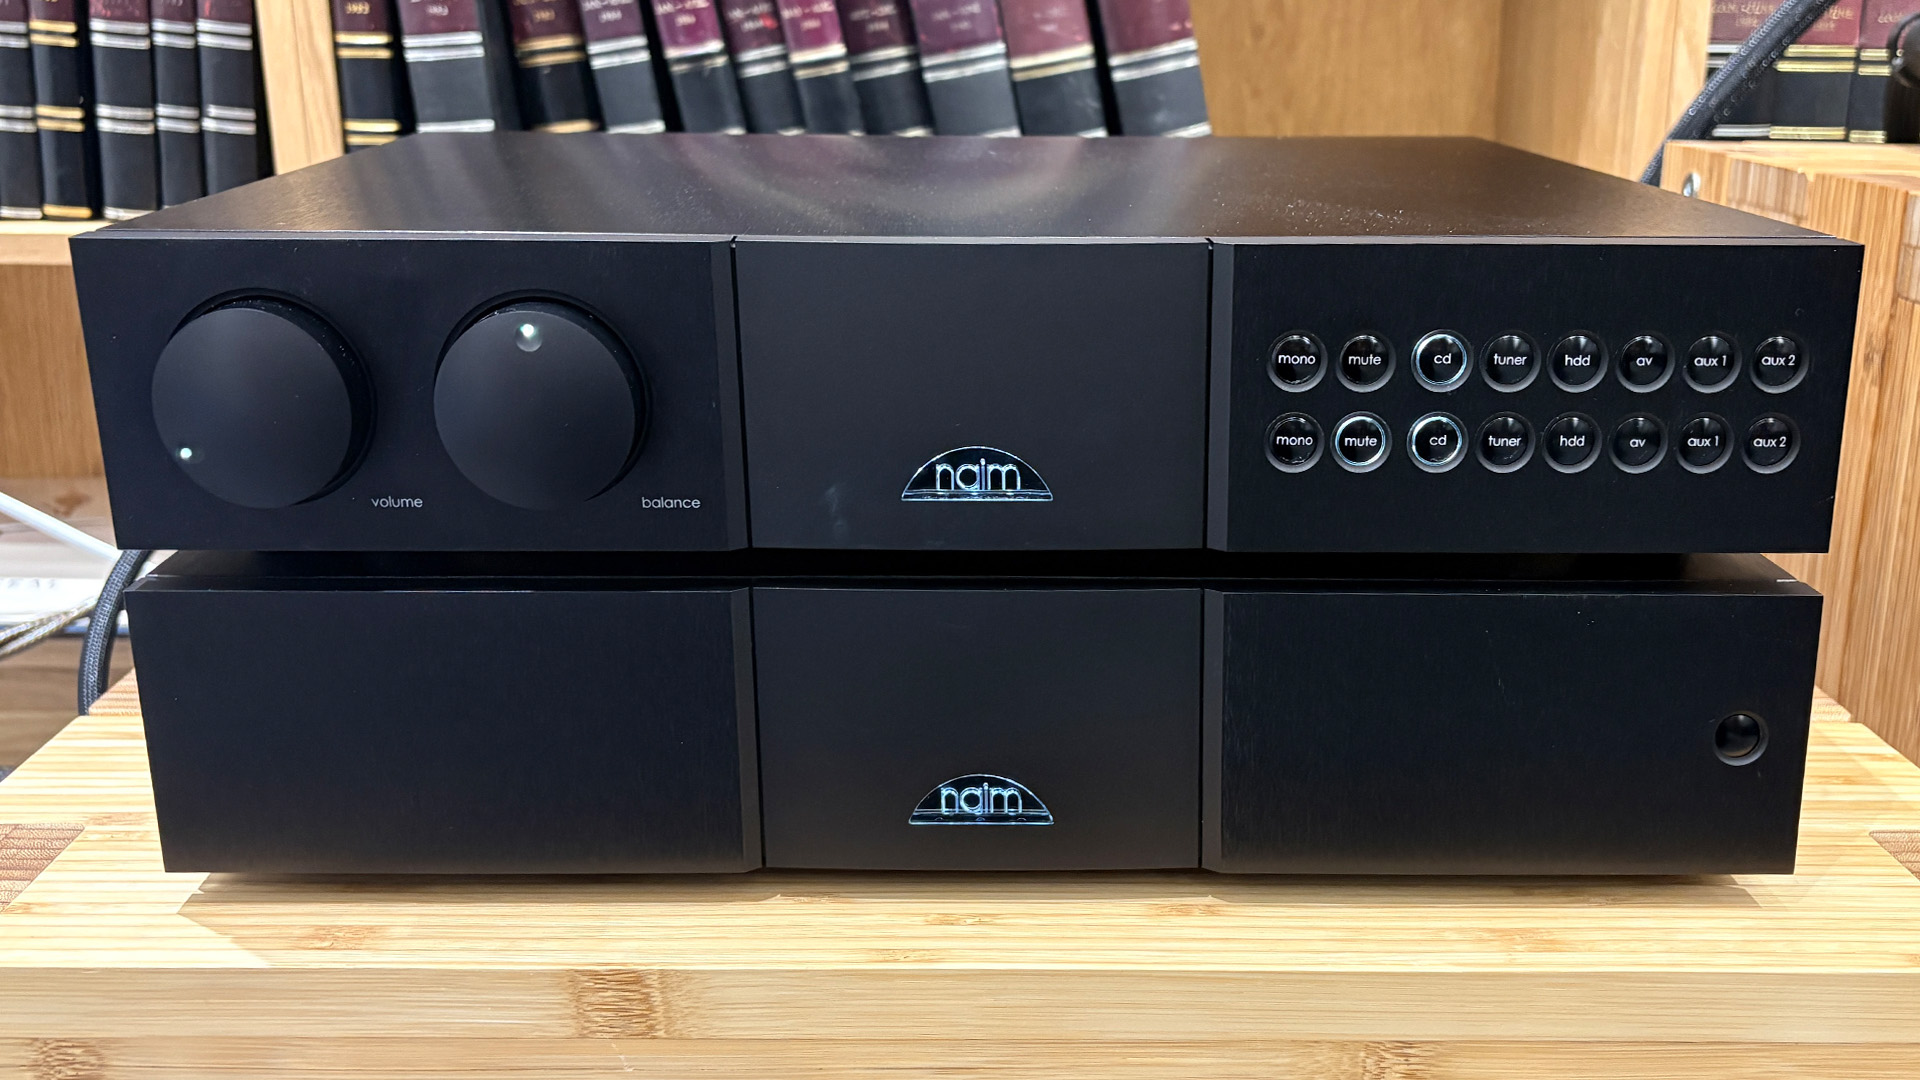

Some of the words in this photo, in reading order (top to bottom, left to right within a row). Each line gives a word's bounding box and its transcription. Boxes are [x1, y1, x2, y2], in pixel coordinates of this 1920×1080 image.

[1277, 354, 1316, 365] mono
[1347, 354, 1382, 366] mute
[1433, 352, 1452, 365] cd
[1493, 354, 1528, 367] tuner
[1564, 354, 1591, 367] hdd
[1635, 357, 1653, 367] av
[1693, 357, 1719, 367] aux
[1722, 355, 1728, 367] 1
[1761, 357, 1785, 367] aux
[1786, 354, 1796, 366] 2
[1275, 435, 1314, 446] mono
[1344, 435, 1378, 447] mute
[1429, 434, 1447, 446] cd
[1488, 435, 1522, 447] tuner
[1559, 434, 1585, 447] hdd
[1629, 438, 1646, 448] av
[1687, 437, 1712, 447] aux
[1714, 435, 1720, 447] 1
[1753, 438, 1777, 448] aux
[1778, 435, 1788, 447] 2
[935, 457, 1021, 491] naim
[371, 495, 423, 508] volume
[641, 496, 701, 509] balance
[940, 782, 1023, 815] naim
